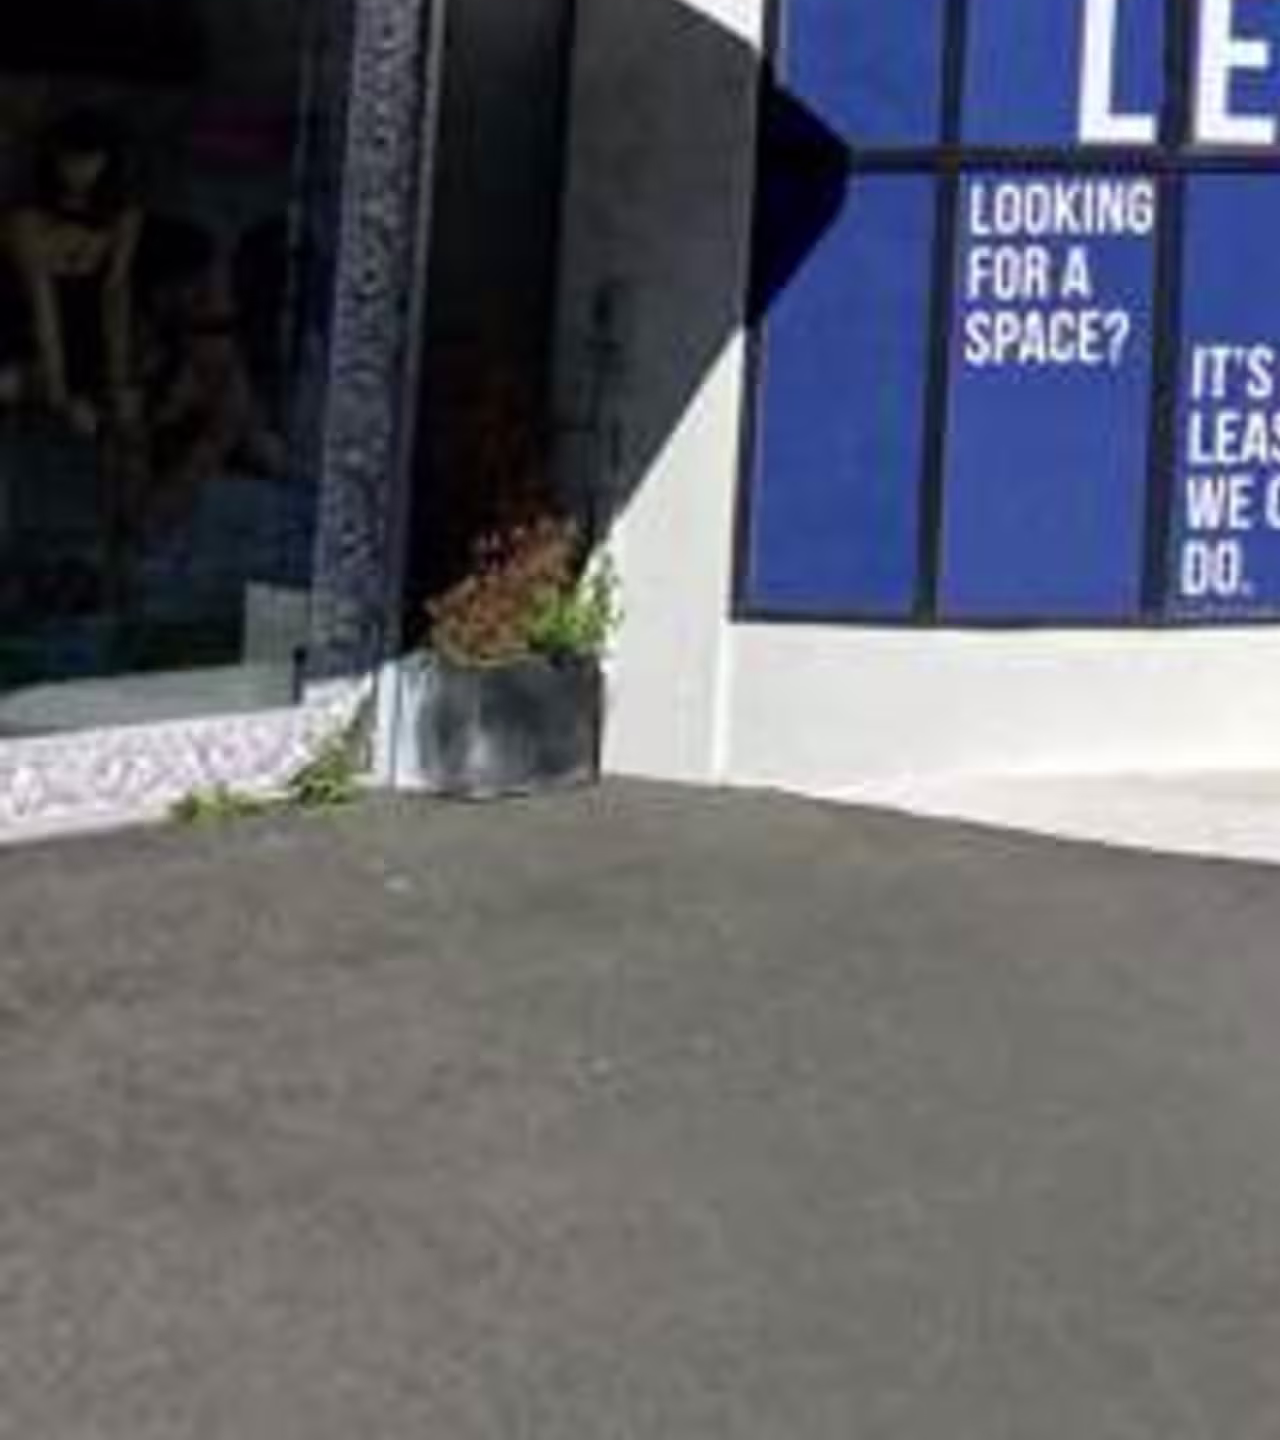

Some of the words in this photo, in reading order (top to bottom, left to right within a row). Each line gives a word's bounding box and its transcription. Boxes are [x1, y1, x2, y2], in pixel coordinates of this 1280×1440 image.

[968, 180, 1155, 237] LOOKING
[967, 245, 1050, 301] FOR
[1060, 245, 1093, 297] A
[963, 310, 1131, 368] SPACE?
[1192, 343, 1275, 401] IT'S
[1186, 474, 1254, 530] WE
[1181, 539, 1254, 596] DO.
